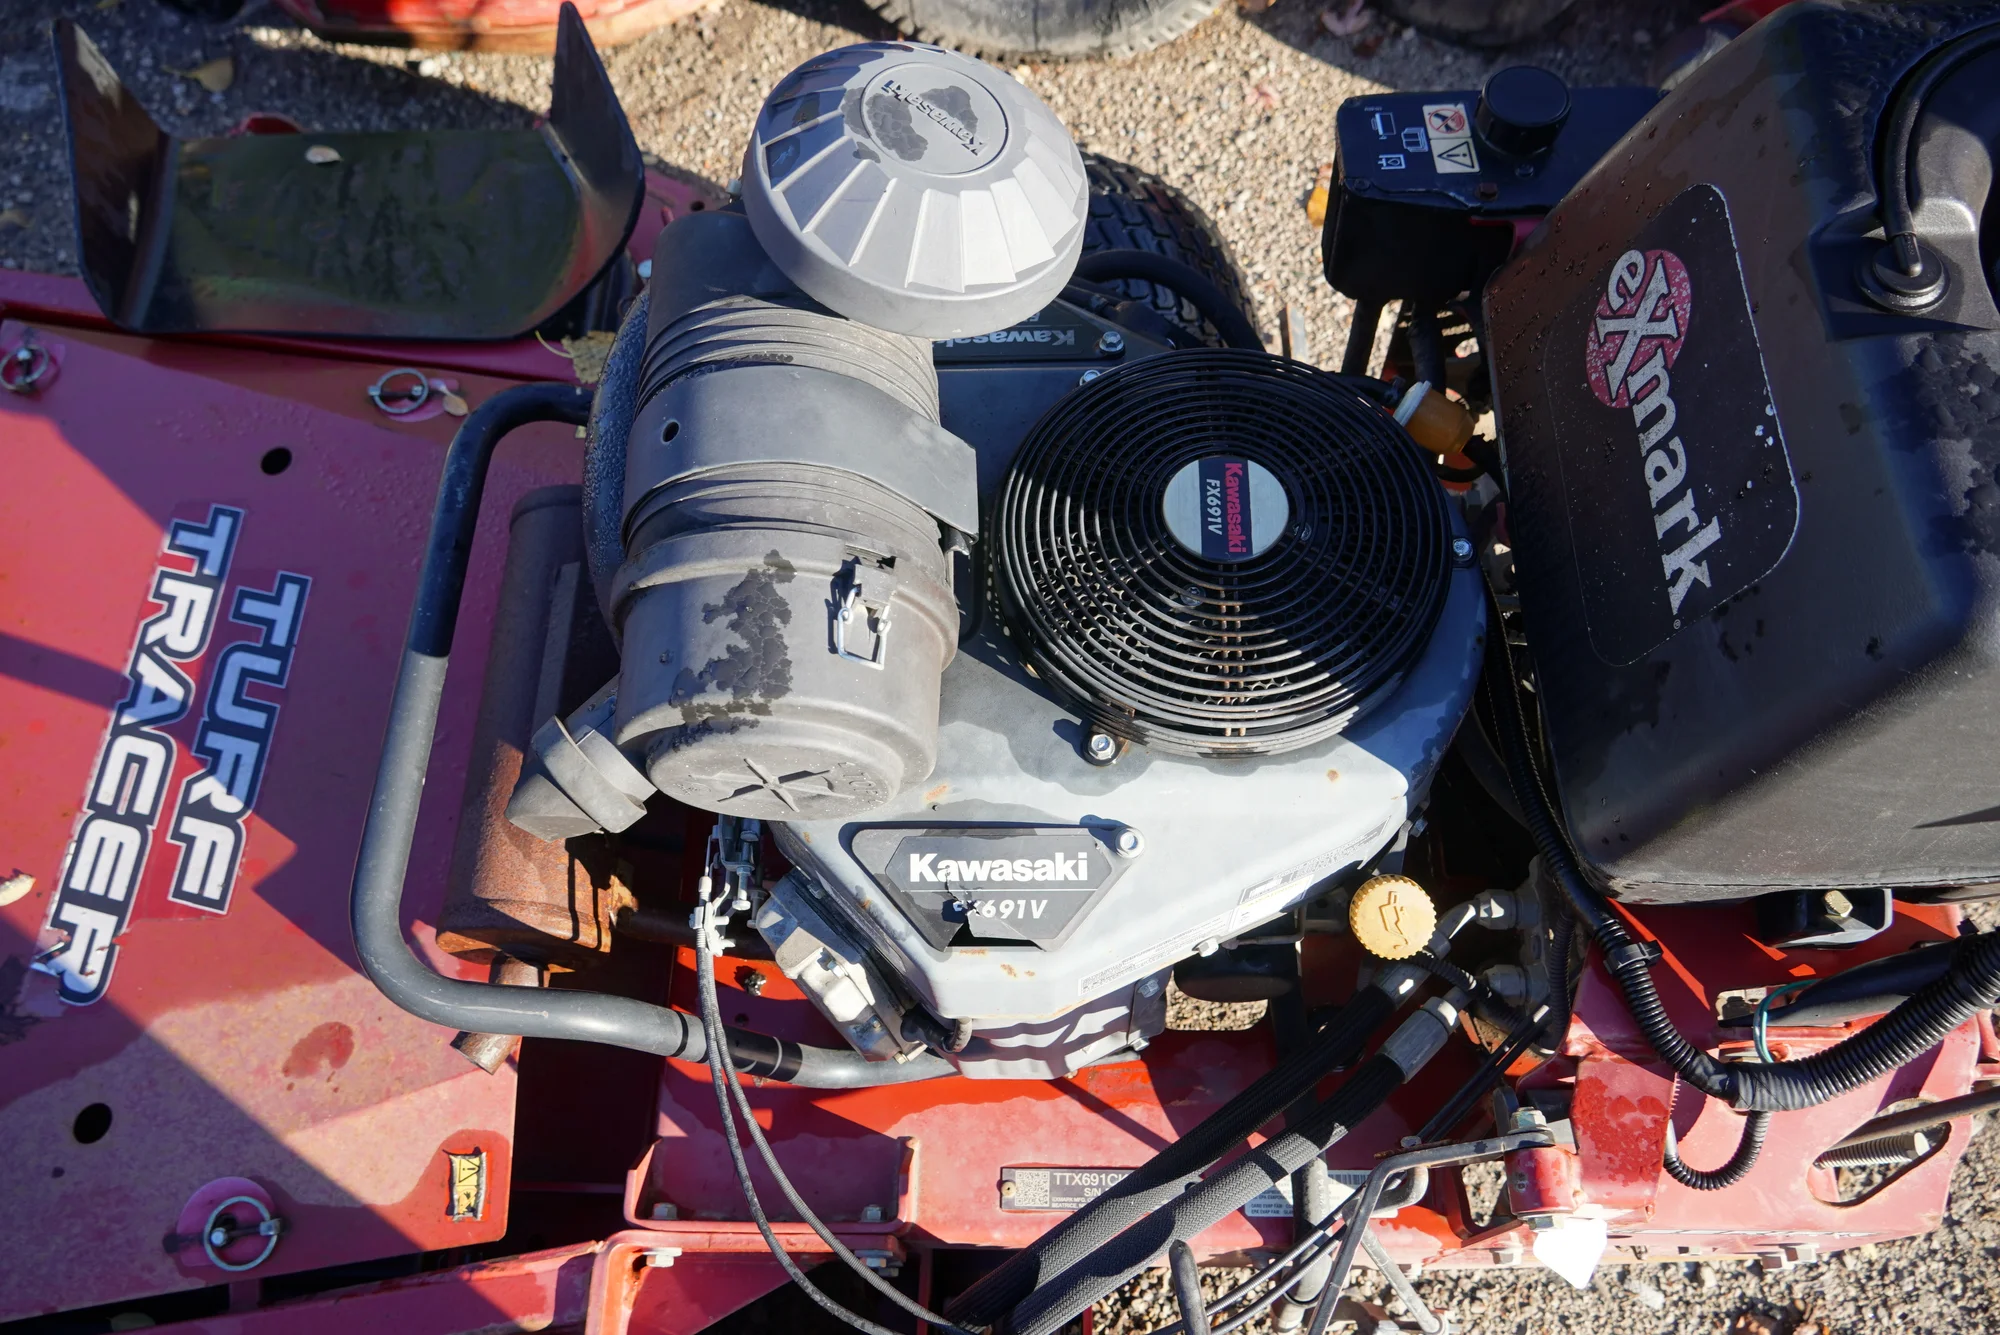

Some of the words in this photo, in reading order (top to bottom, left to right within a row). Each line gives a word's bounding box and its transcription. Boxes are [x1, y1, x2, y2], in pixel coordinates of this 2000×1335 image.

[880, 79, 988, 156] Kawasaki
[931, 329, 1075, 347] Kawas
[1206, 478, 1223, 536] FX691V
[1224, 462, 1247, 553] Kawasaki
[31, 506, 243, 1005] TRACER
[172, 573, 309, 911] TURF
[909, 852, 1088, 882] Kawasaki
[1083, 1187, 1101, 1197] S/N
